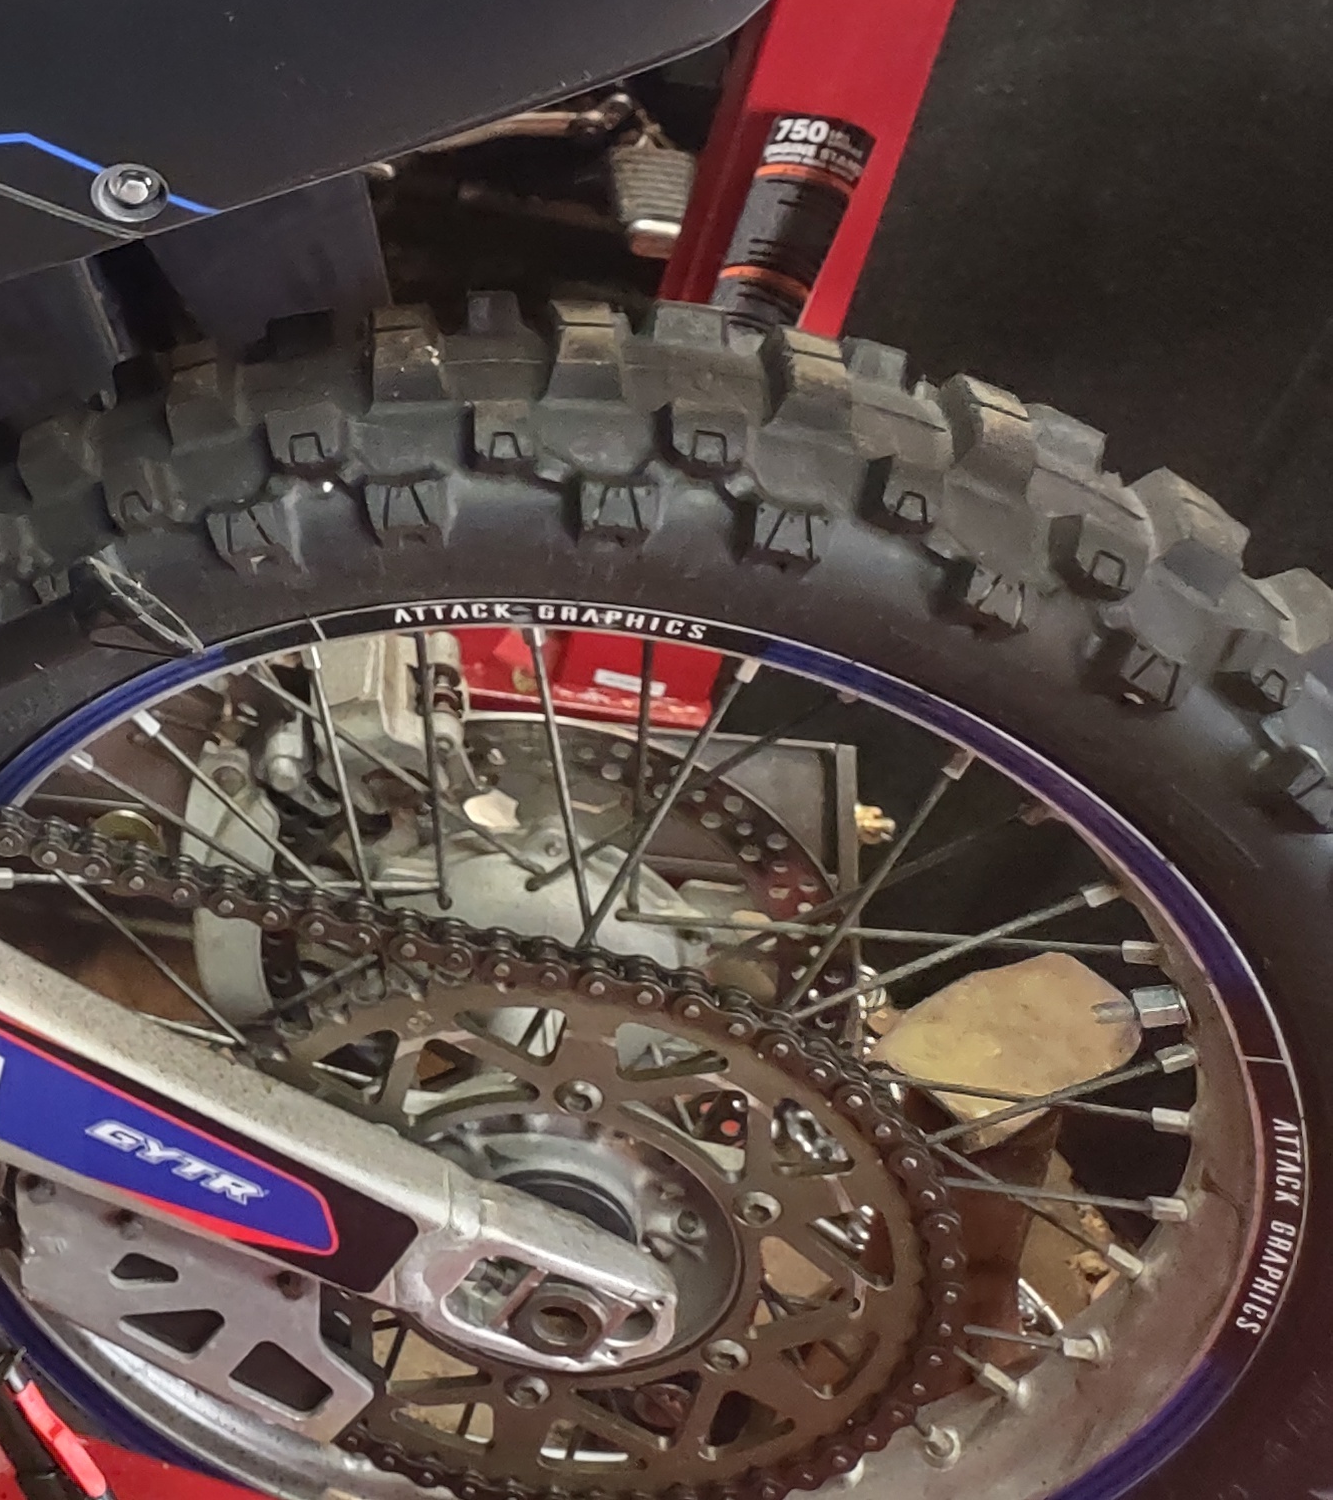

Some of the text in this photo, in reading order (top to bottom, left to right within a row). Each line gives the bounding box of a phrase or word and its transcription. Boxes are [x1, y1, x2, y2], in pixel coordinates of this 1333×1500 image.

[394, 602, 707, 640] ATTACK GRAPHICS
[85, 1119, 265, 1206] GYTR
[1235, 1116, 1302, 1335] ATTACK GRAPHICS
